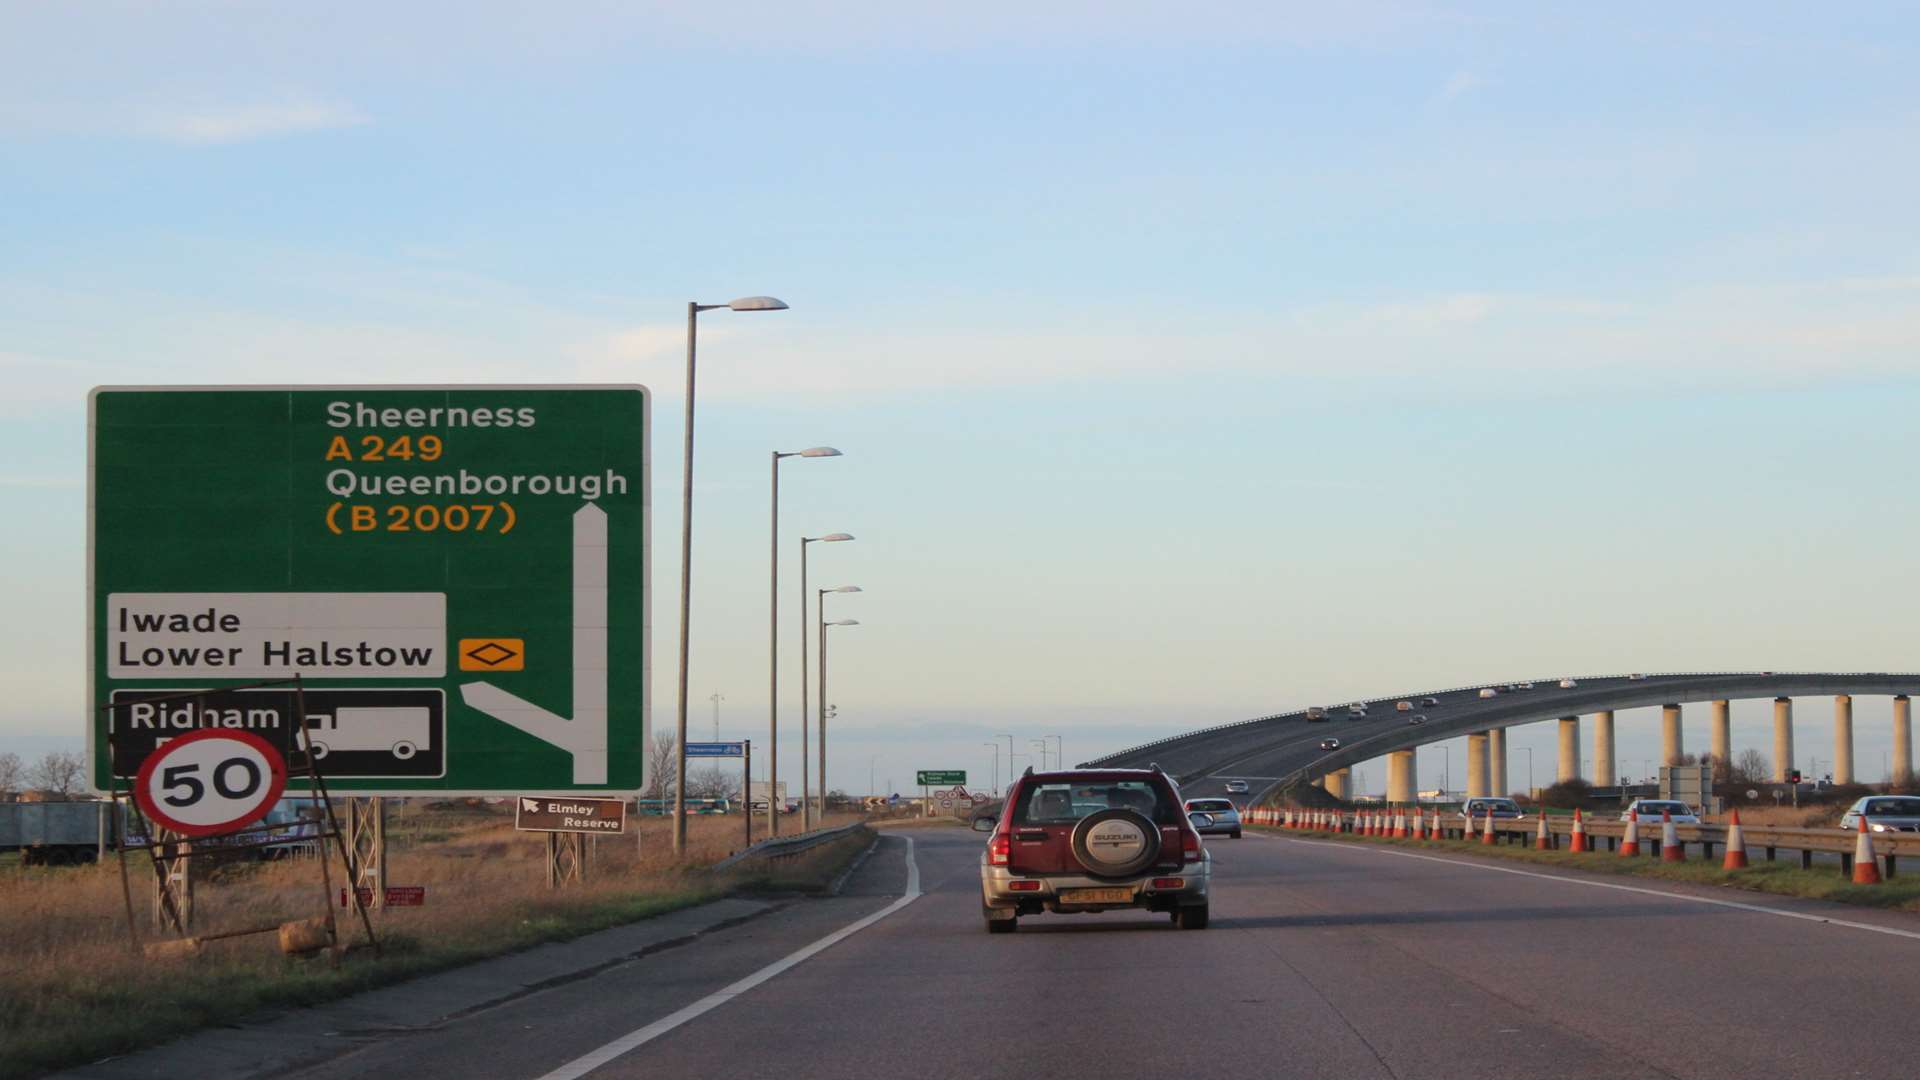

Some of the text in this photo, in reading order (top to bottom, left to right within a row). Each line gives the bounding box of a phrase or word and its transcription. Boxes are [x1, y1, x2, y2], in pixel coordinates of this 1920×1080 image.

[327, 401, 535, 428] Sheerness
[326, 468, 628, 499] Queenborough
[119, 607, 241, 633] Iwade
[119, 641, 433, 667] Lower Halstow
[131, 702, 280, 730] Ridham
[162, 756, 262, 808] 50
[547, 803, 594, 816] Elmley
[564, 817, 619, 829] Reserve
[1094, 833, 1138, 841] SUZUKI
